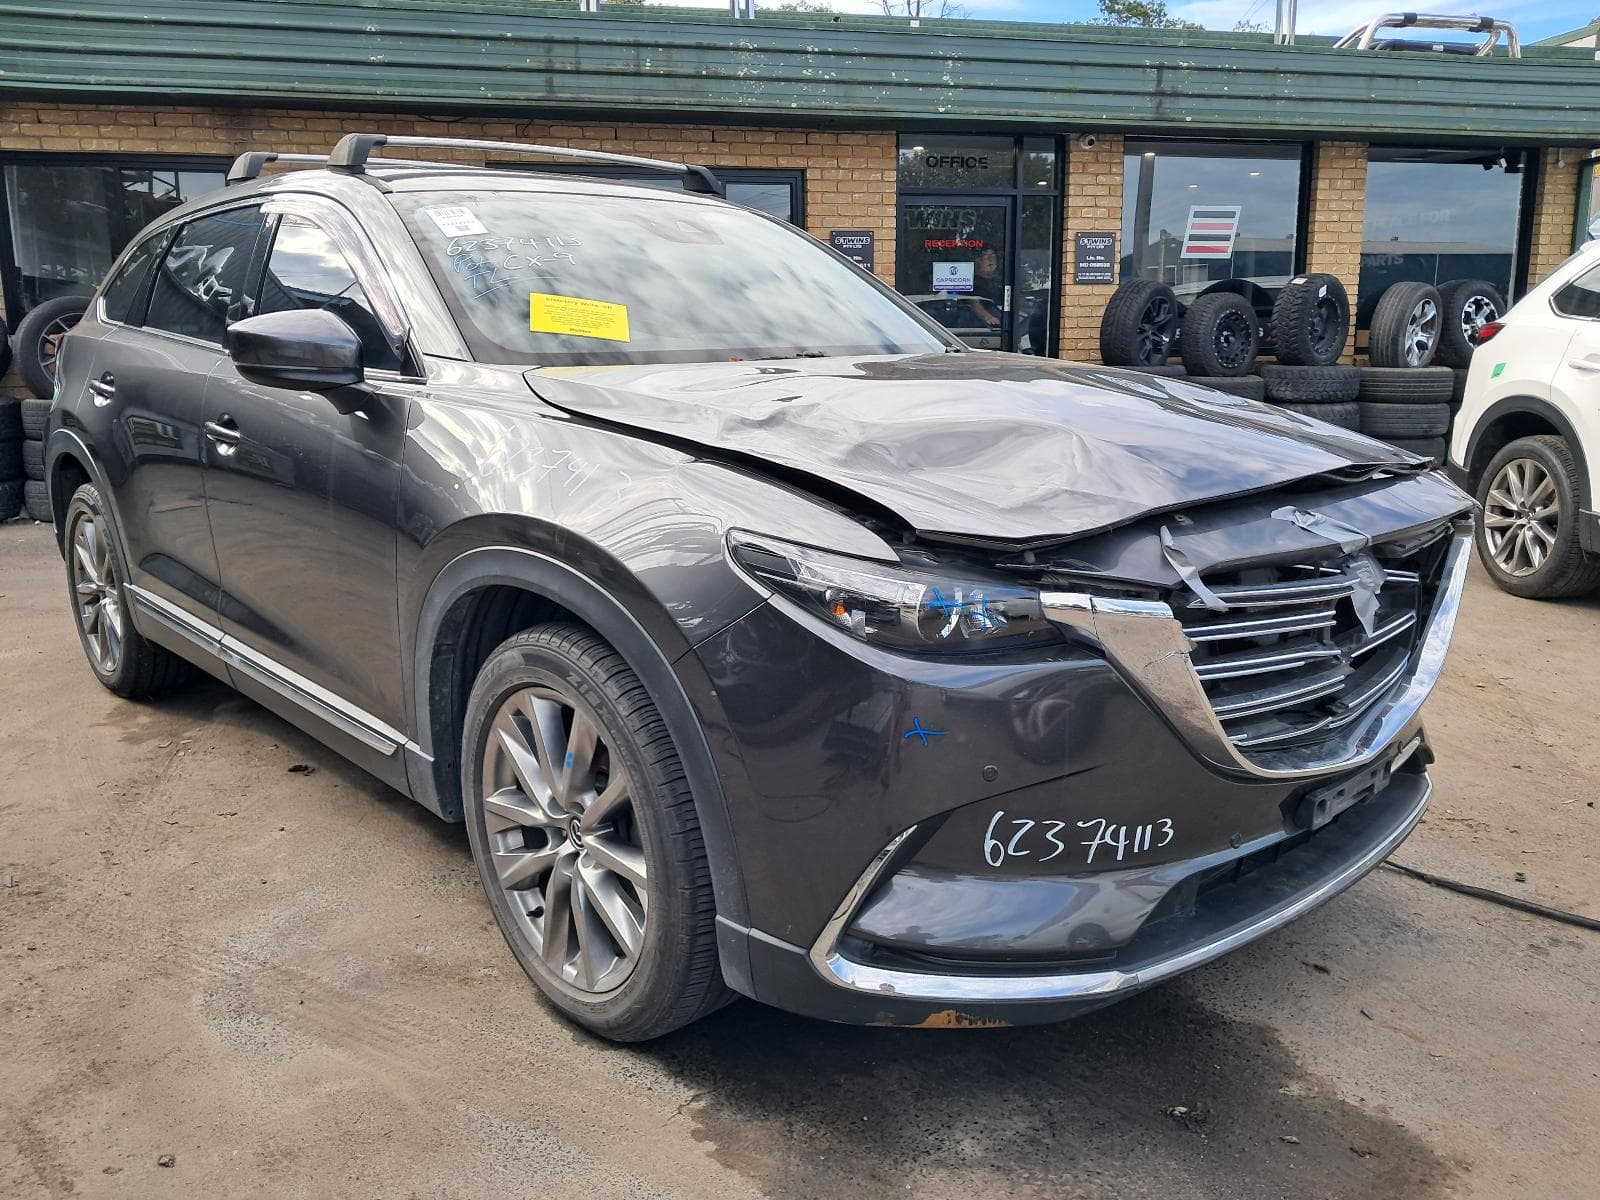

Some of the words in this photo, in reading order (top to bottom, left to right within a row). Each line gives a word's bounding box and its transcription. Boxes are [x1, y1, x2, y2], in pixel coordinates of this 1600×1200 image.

[926, 156, 988, 169] OFFICE
[446, 236, 582, 256] 62374113
[924, 240, 984, 248] RECEPTION
[983, 811, 1175, 867] 62374113
